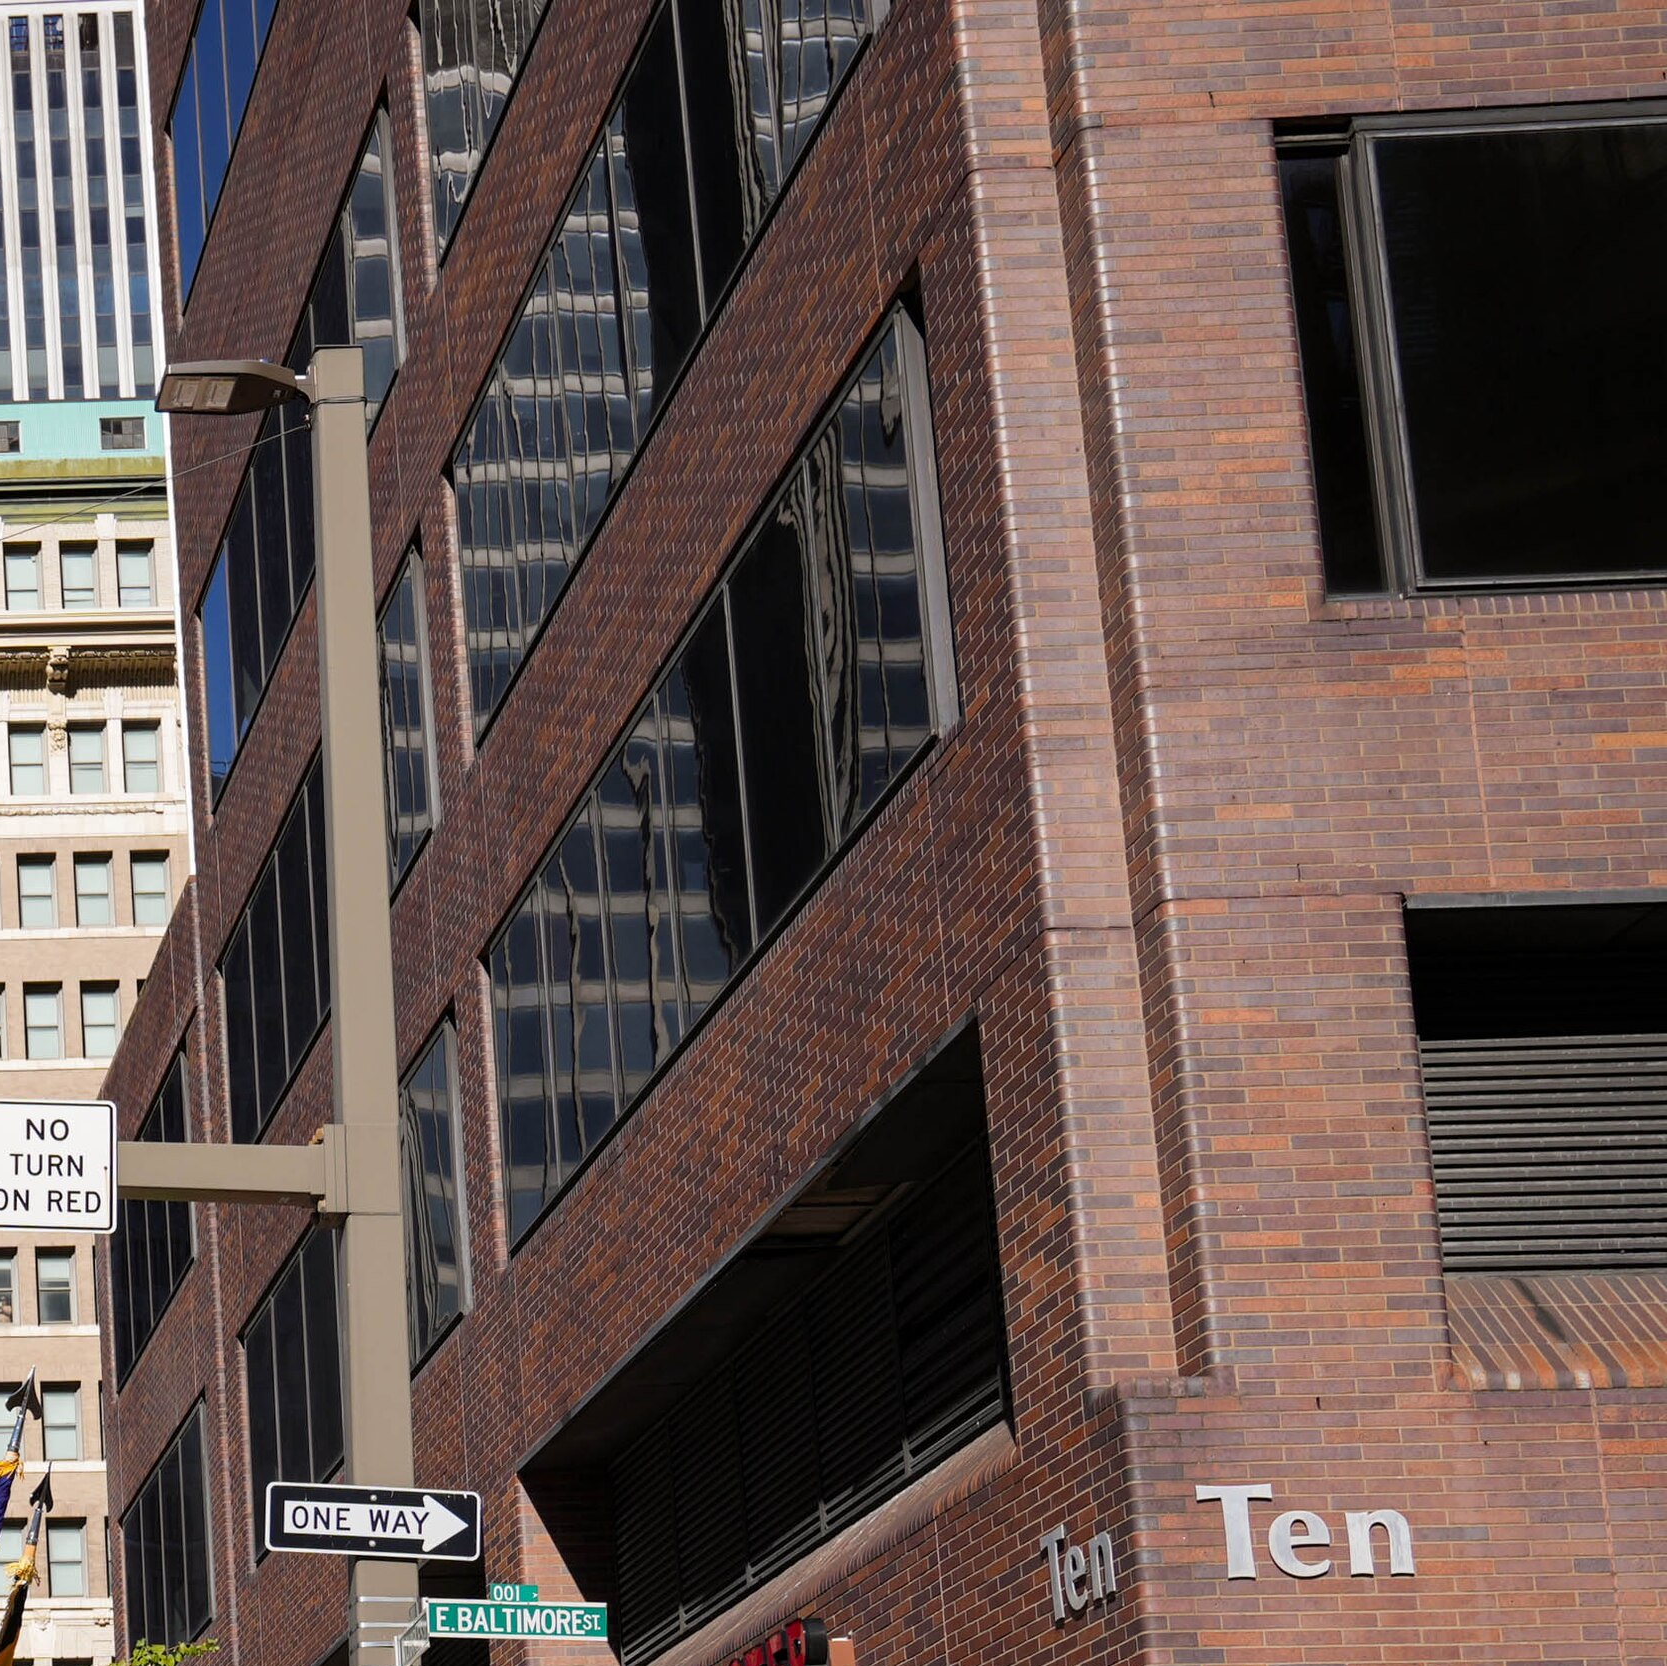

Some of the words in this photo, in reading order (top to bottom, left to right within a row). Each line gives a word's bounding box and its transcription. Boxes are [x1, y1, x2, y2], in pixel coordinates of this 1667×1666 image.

[23, 1117, 70, 1143] NO
[8, 1153, 85, 1178] TURN
[47, 1188, 102, 1214] RED
[291, 1505, 352, 1531] ONE
[369, 1509, 430, 1536] WAY
[1196, 1484, 1415, 1579] Ten
[1040, 1523, 1118, 1624] Ten
